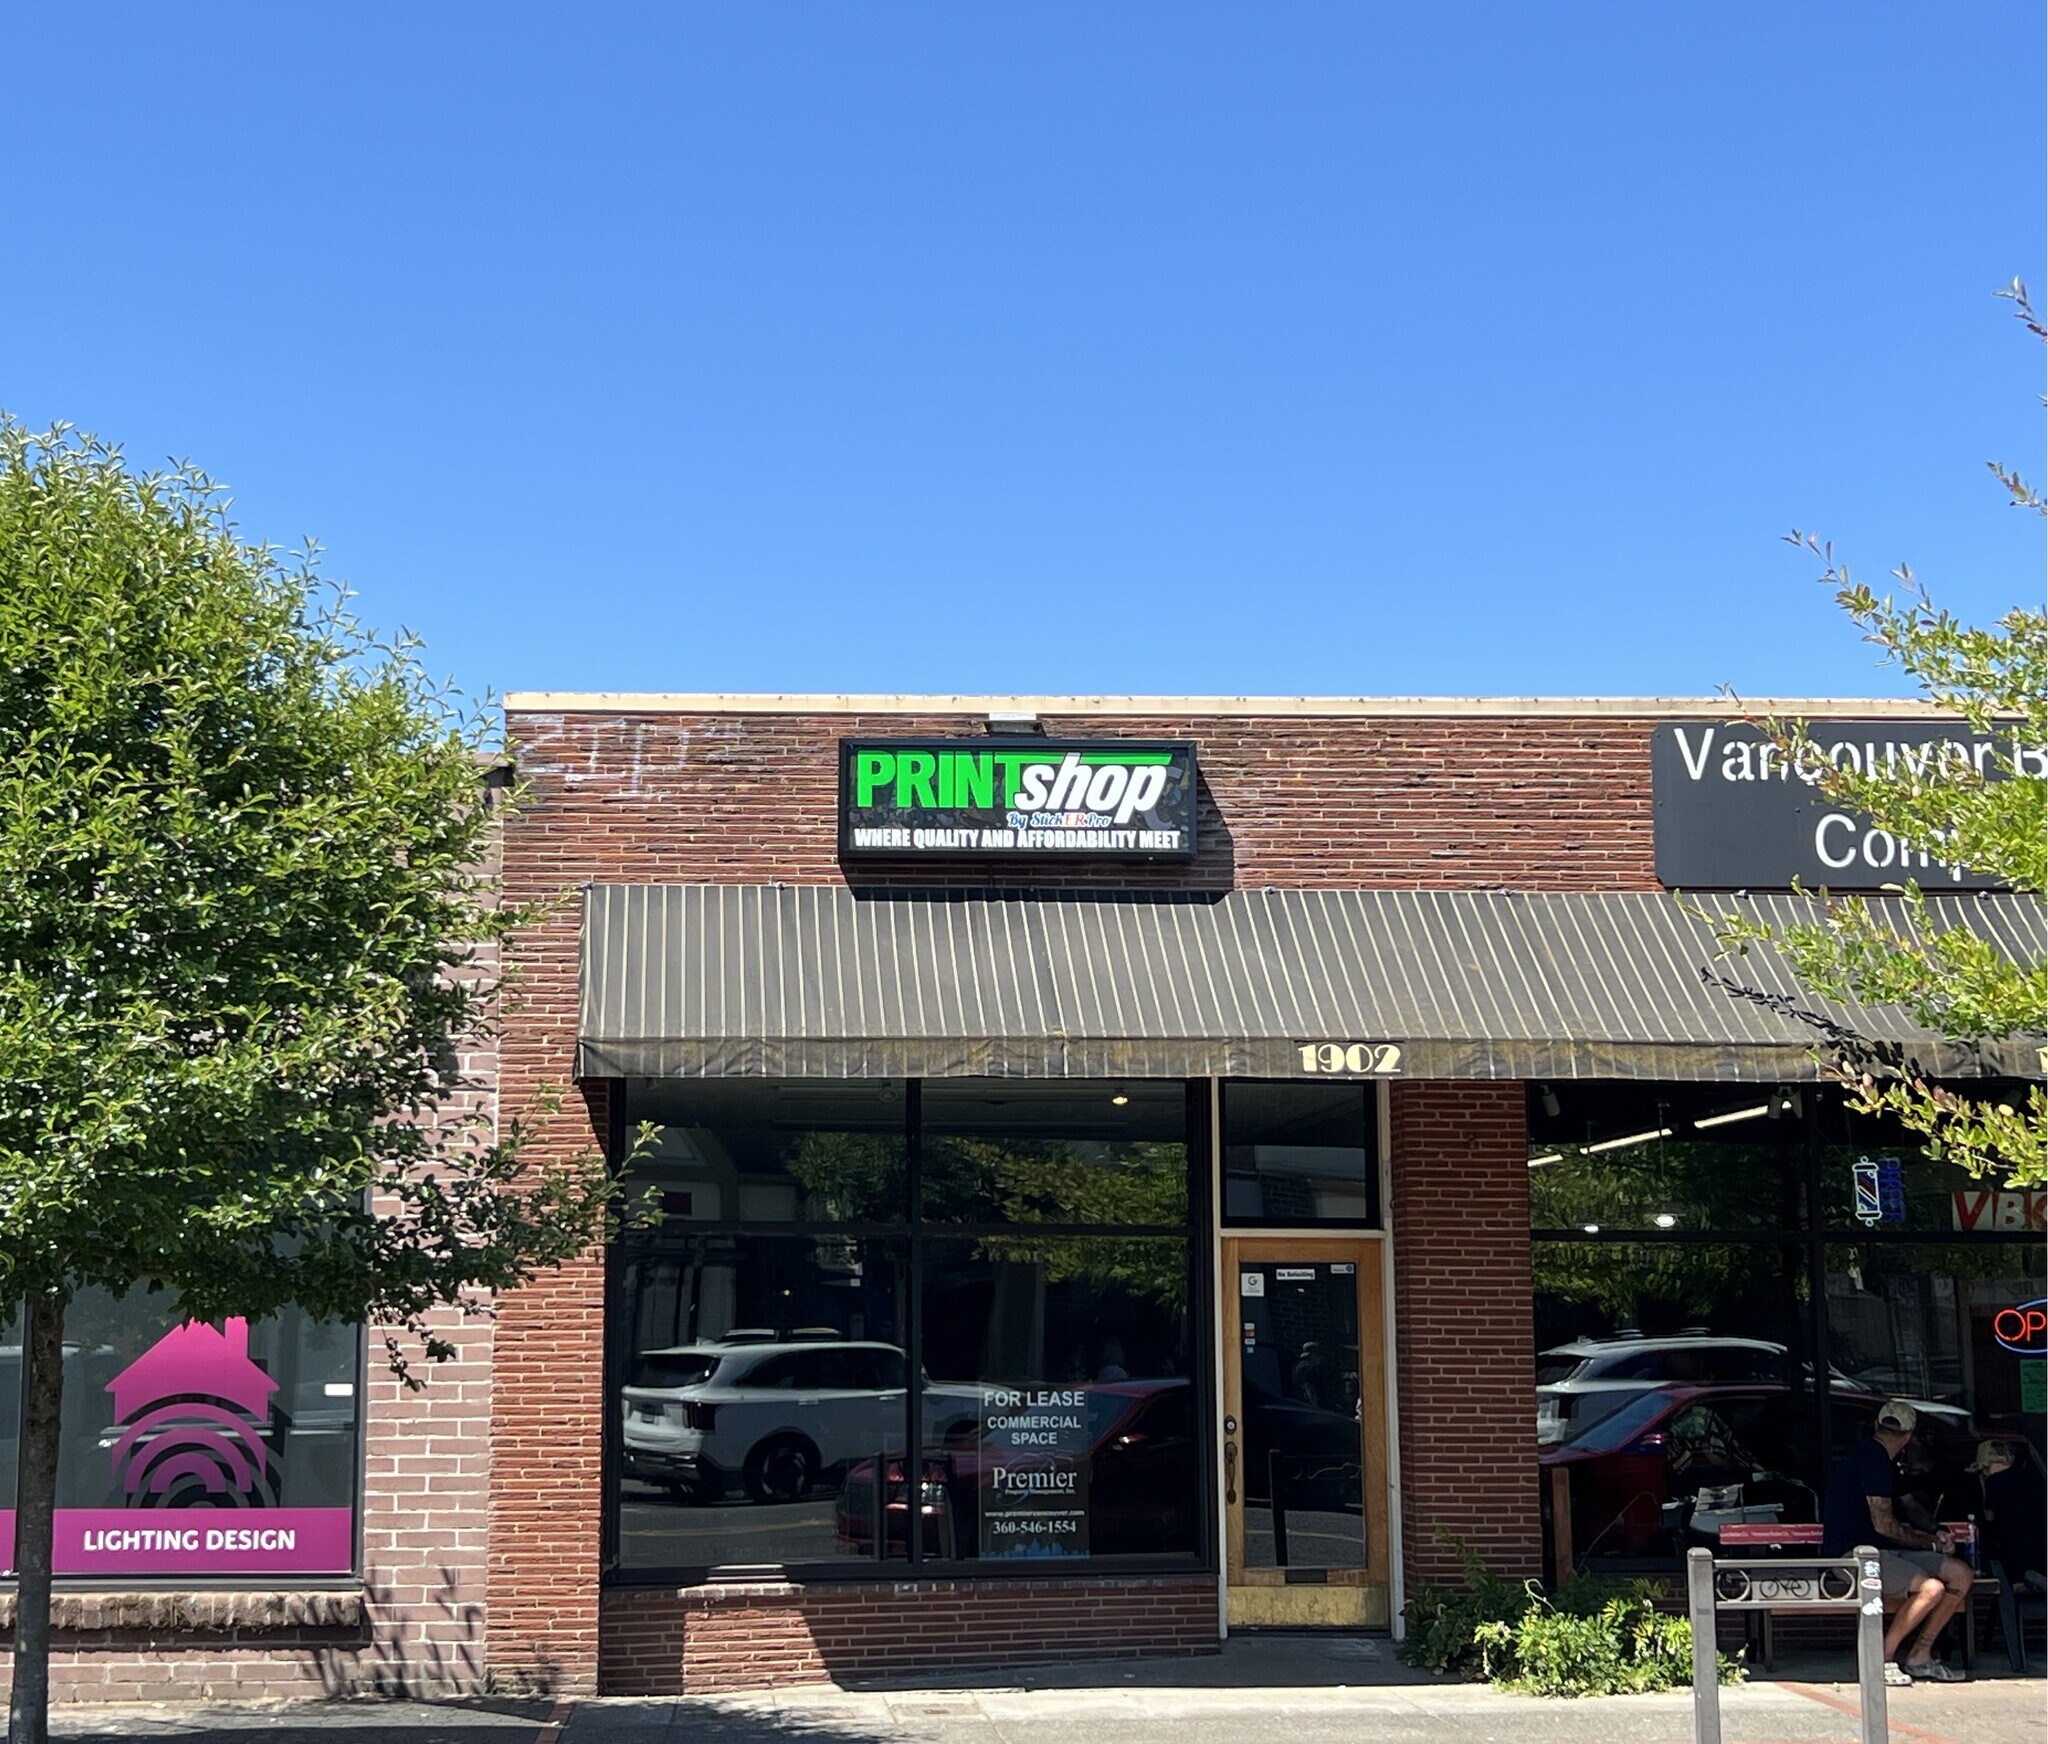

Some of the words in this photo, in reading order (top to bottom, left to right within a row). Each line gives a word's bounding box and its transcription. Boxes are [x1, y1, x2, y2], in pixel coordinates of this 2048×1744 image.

[1006, 811, 1028, 829] By
[854, 828, 911, 847] WHERE
[913, 828, 980, 849] QUALITY
[980, 829, 1014, 848] AND
[1016, 830, 1136, 849] AFFORDABILITY
[1139, 831, 1181, 849] MEET
[1297, 1043, 1401, 1073] 1902
[984, 1390, 1022, 1407] FOR
[1026, 1390, 1085, 1407] LEASE
[987, 1415, 1082, 1430] COMMERCIAL
[1011, 1431, 1058, 1445] SPACE
[992, 1465, 1078, 1489] Premier
[993, 1520, 1077, 1534] 360-546-1554
[83, 1529, 200, 1551] LIGHTING
[205, 1529, 296, 1551] DESIGN
